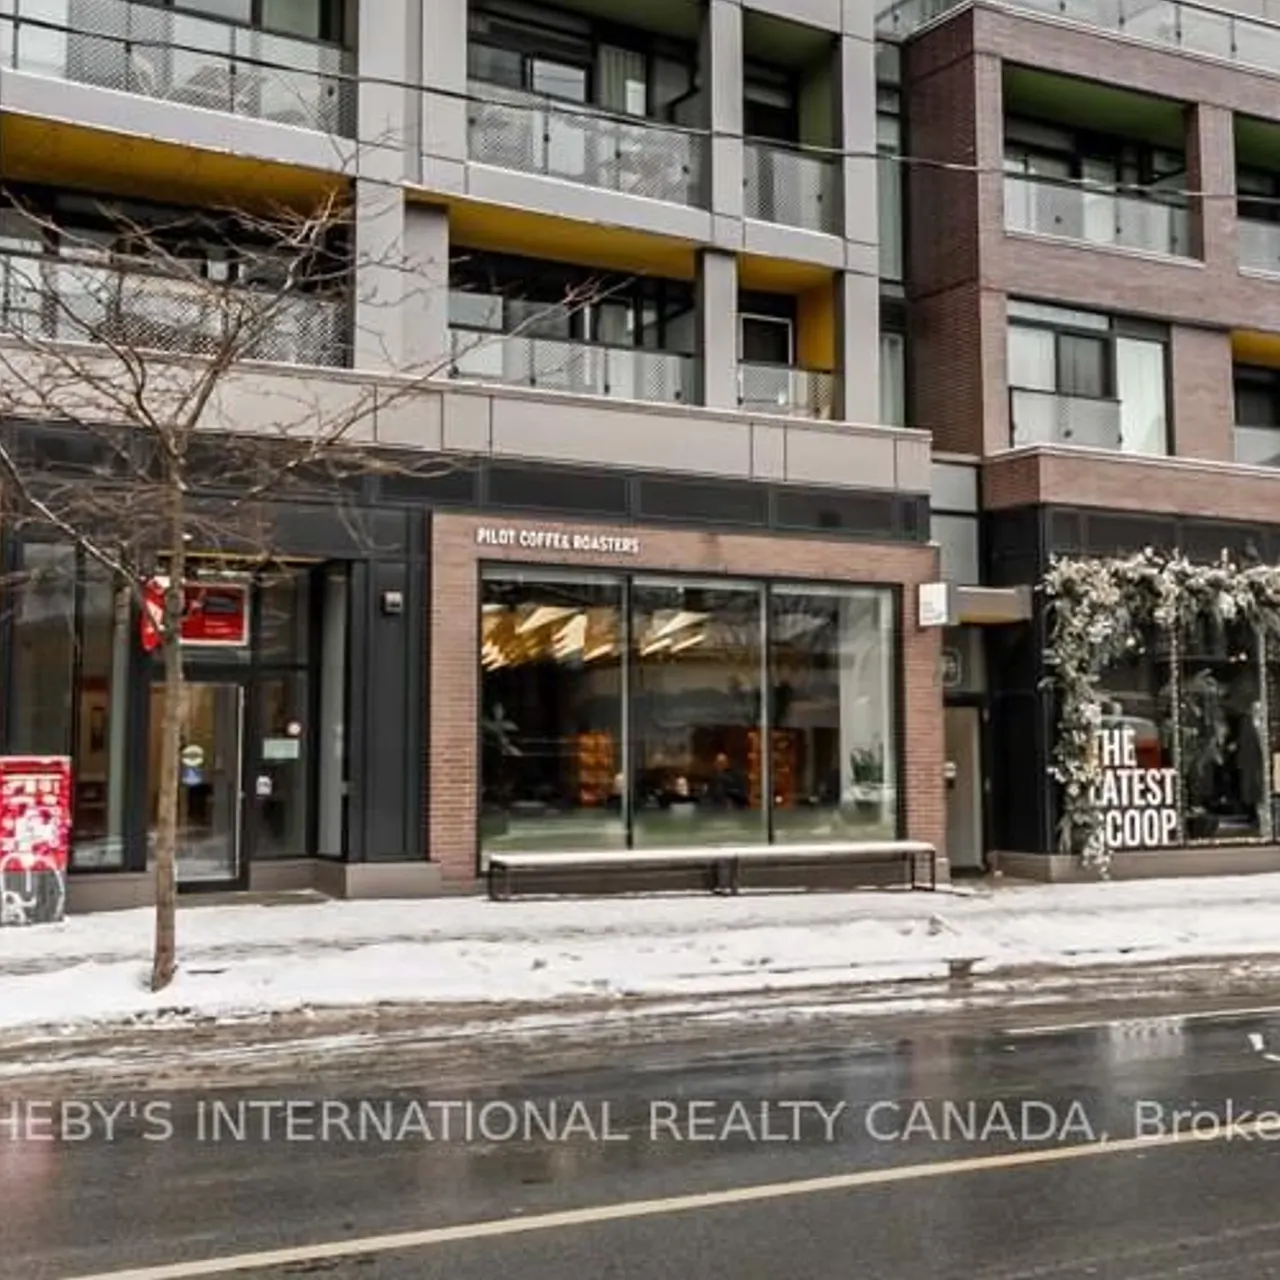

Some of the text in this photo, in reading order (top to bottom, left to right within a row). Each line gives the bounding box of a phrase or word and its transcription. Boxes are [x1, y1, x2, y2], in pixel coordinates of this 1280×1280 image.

[476, 526, 639, 554] PILOT COFFEE ROASTERS
[1088, 768, 1178, 806] LATEST
